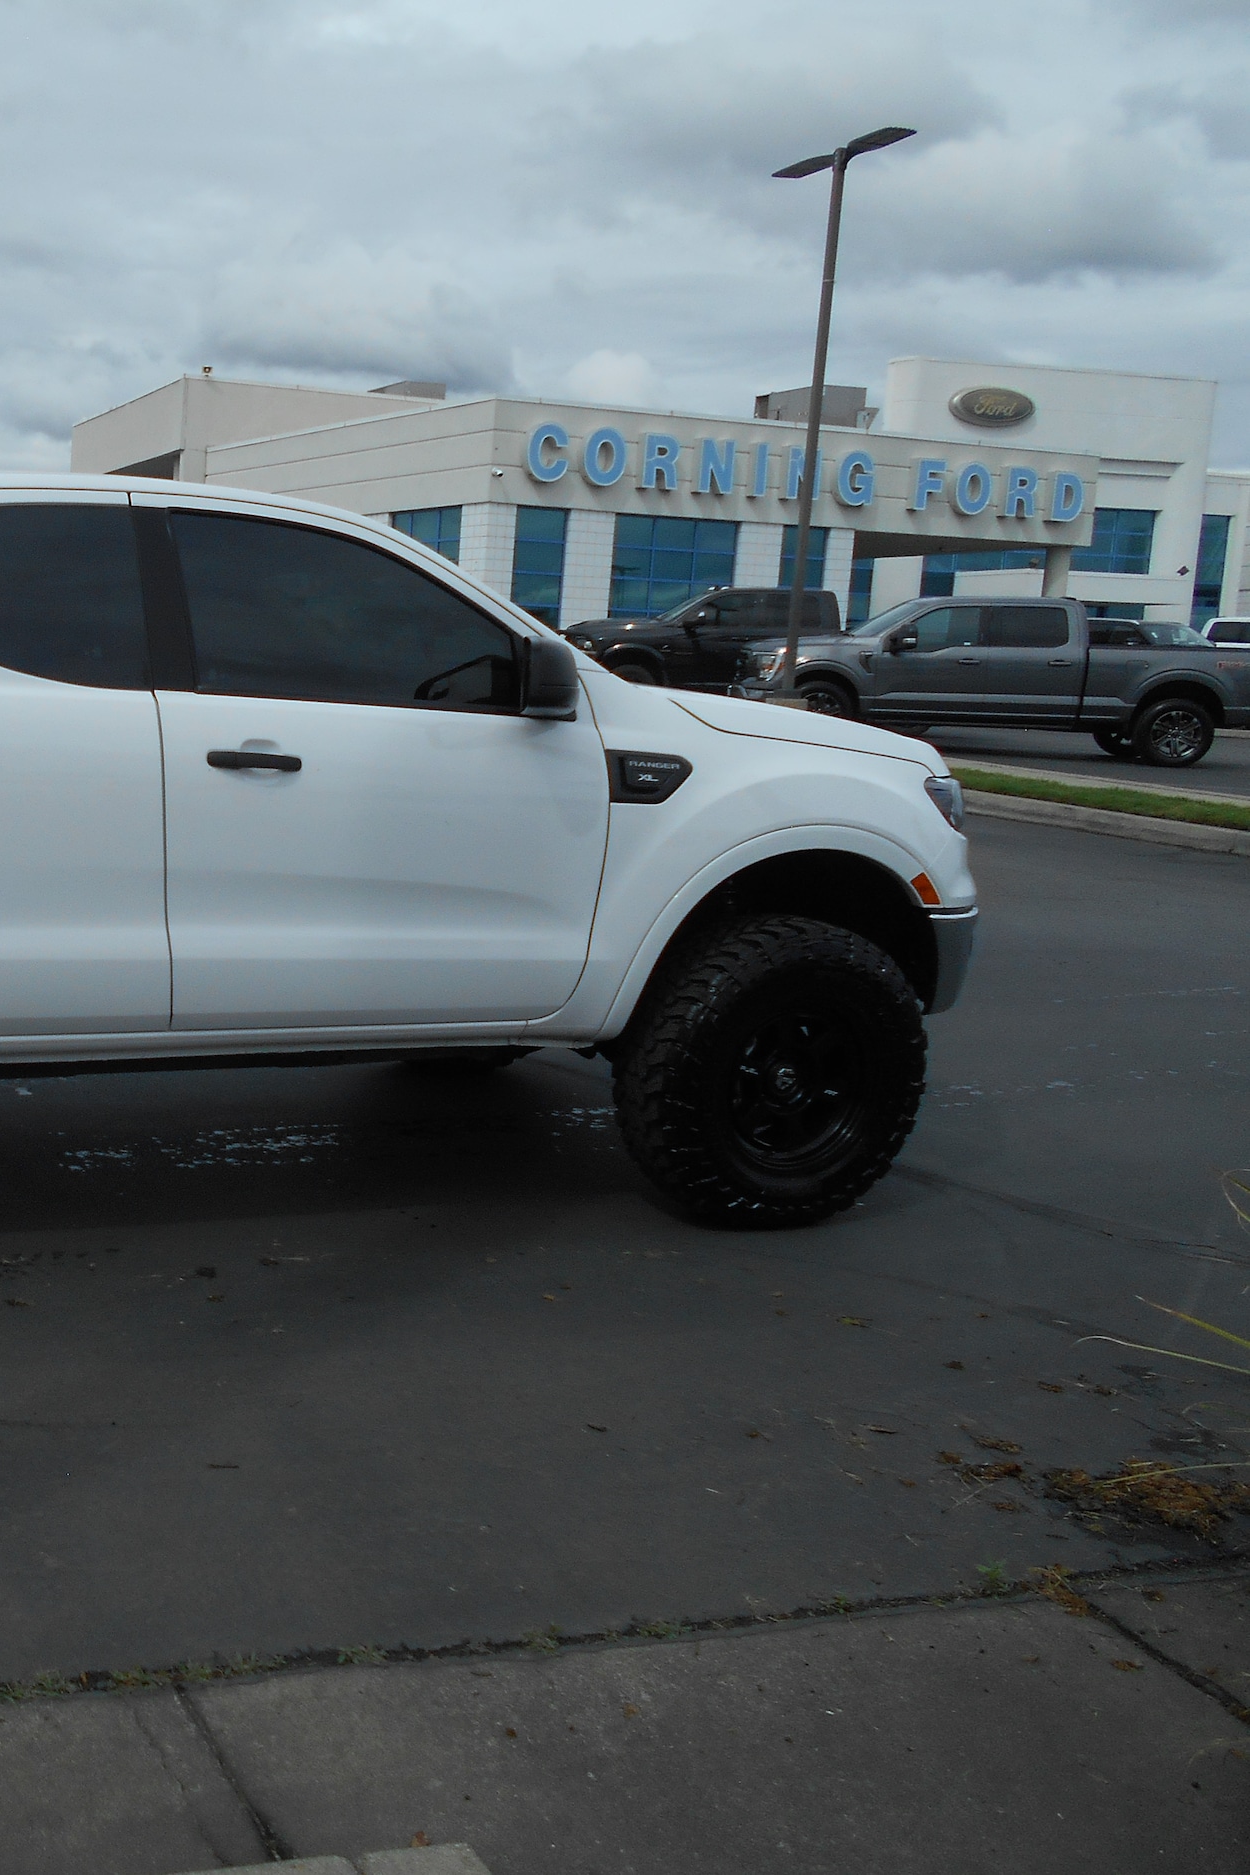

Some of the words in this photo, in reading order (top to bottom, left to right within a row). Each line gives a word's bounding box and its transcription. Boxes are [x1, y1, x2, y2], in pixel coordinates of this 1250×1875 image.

[973, 394, 1018, 417] Ford
[524, 422, 876, 507] CORNING
[910, 457, 1085, 522] FORD
[629, 760, 681, 770] RANGER
[637, 773, 660, 782] XL
